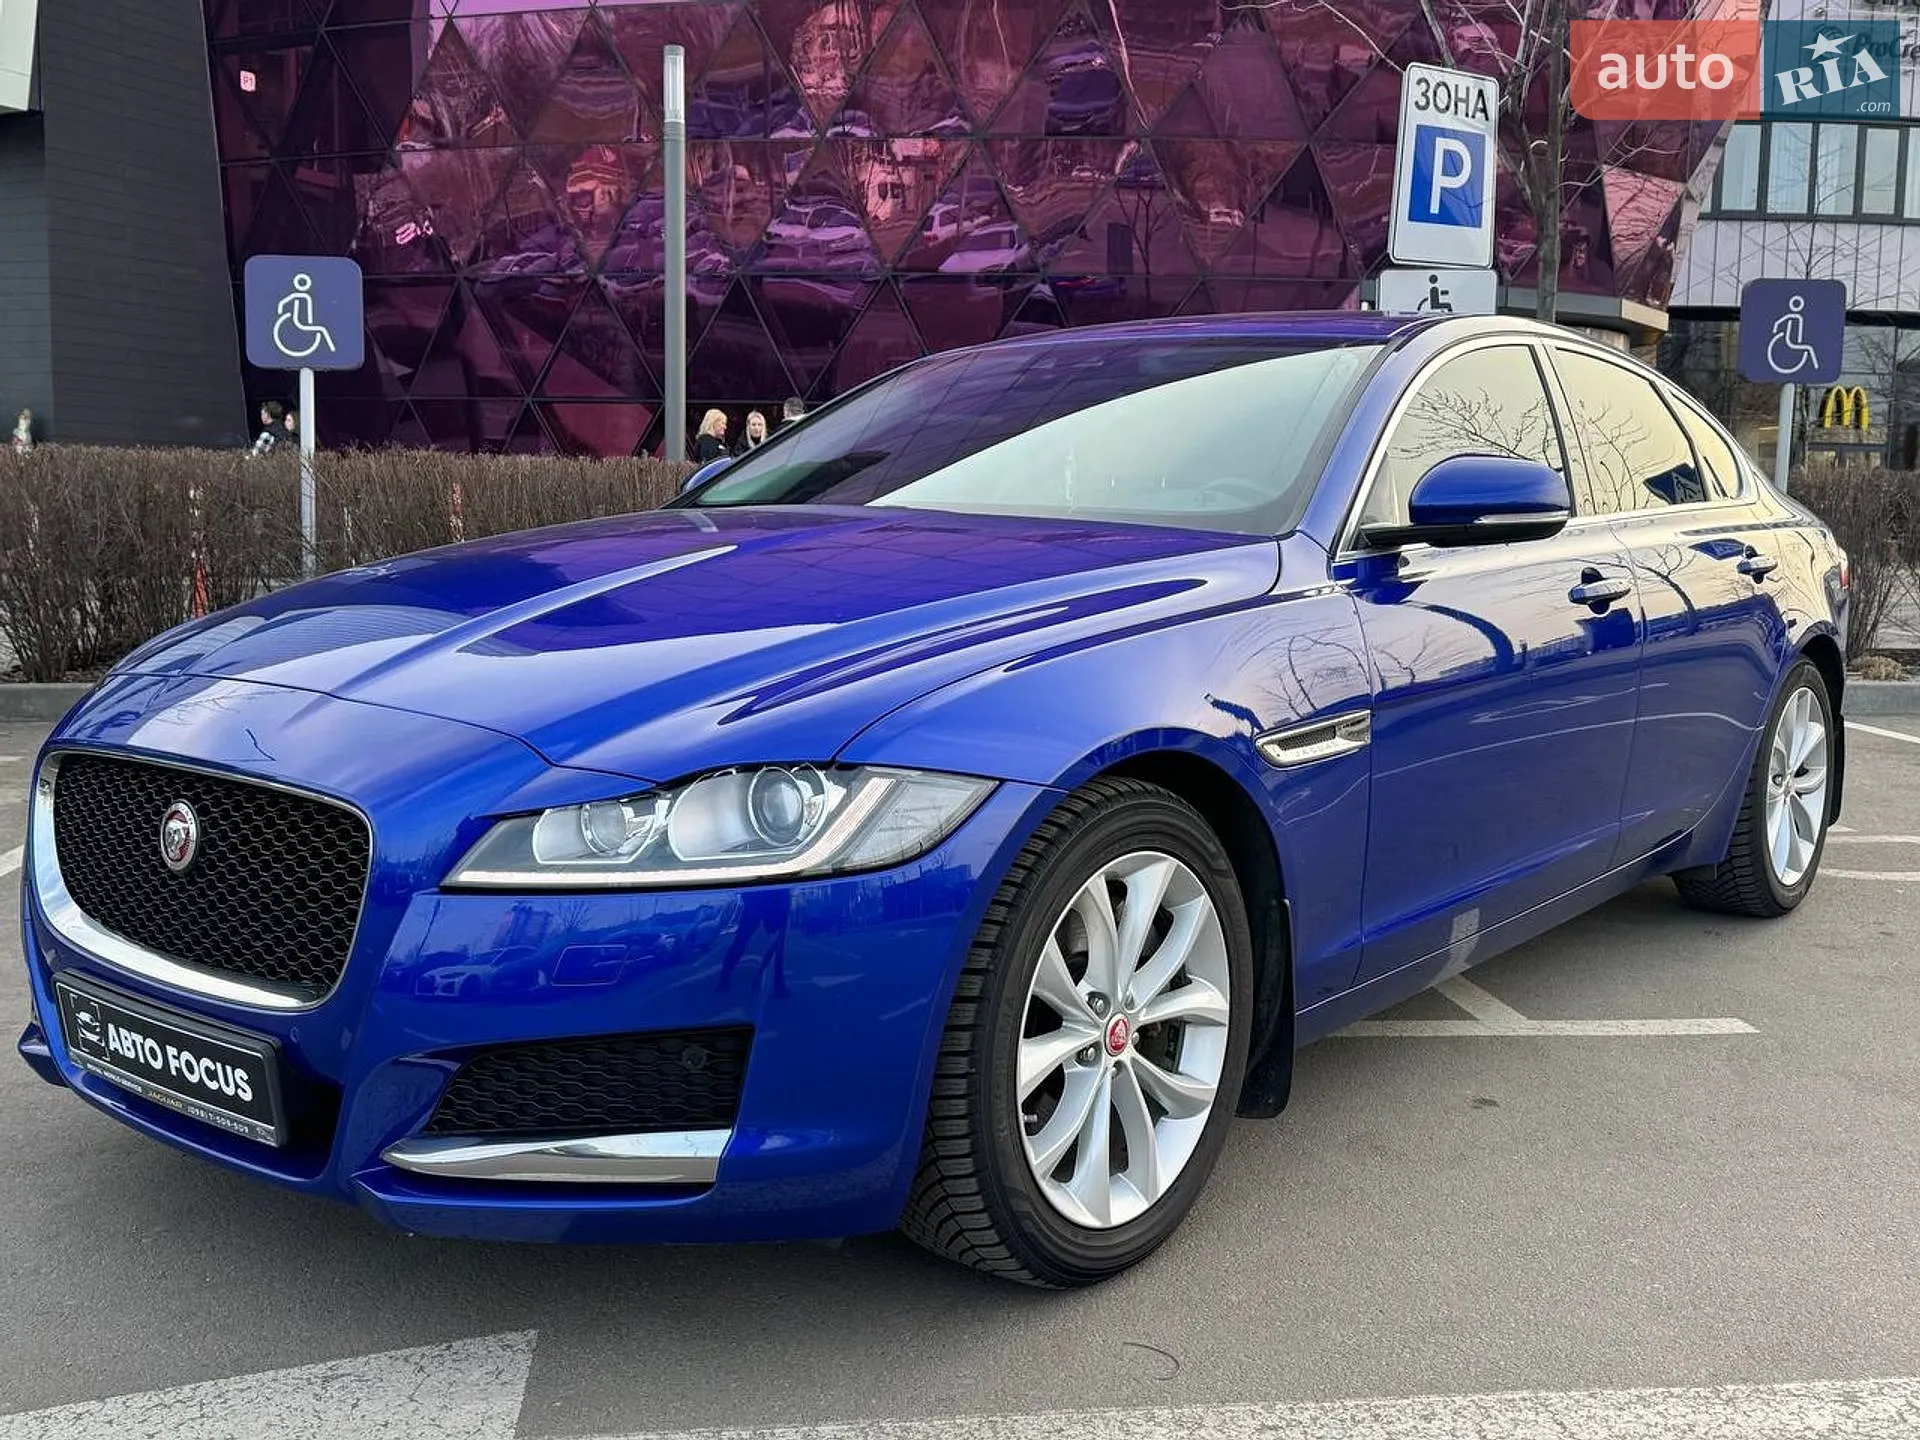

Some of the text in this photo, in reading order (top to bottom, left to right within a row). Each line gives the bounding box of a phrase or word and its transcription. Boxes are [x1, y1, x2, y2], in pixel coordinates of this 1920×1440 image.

[1414, 77, 1489, 122] ЗОНА
[1429, 137, 1472, 215] P
[166, 1044, 254, 1103] FOCUS
